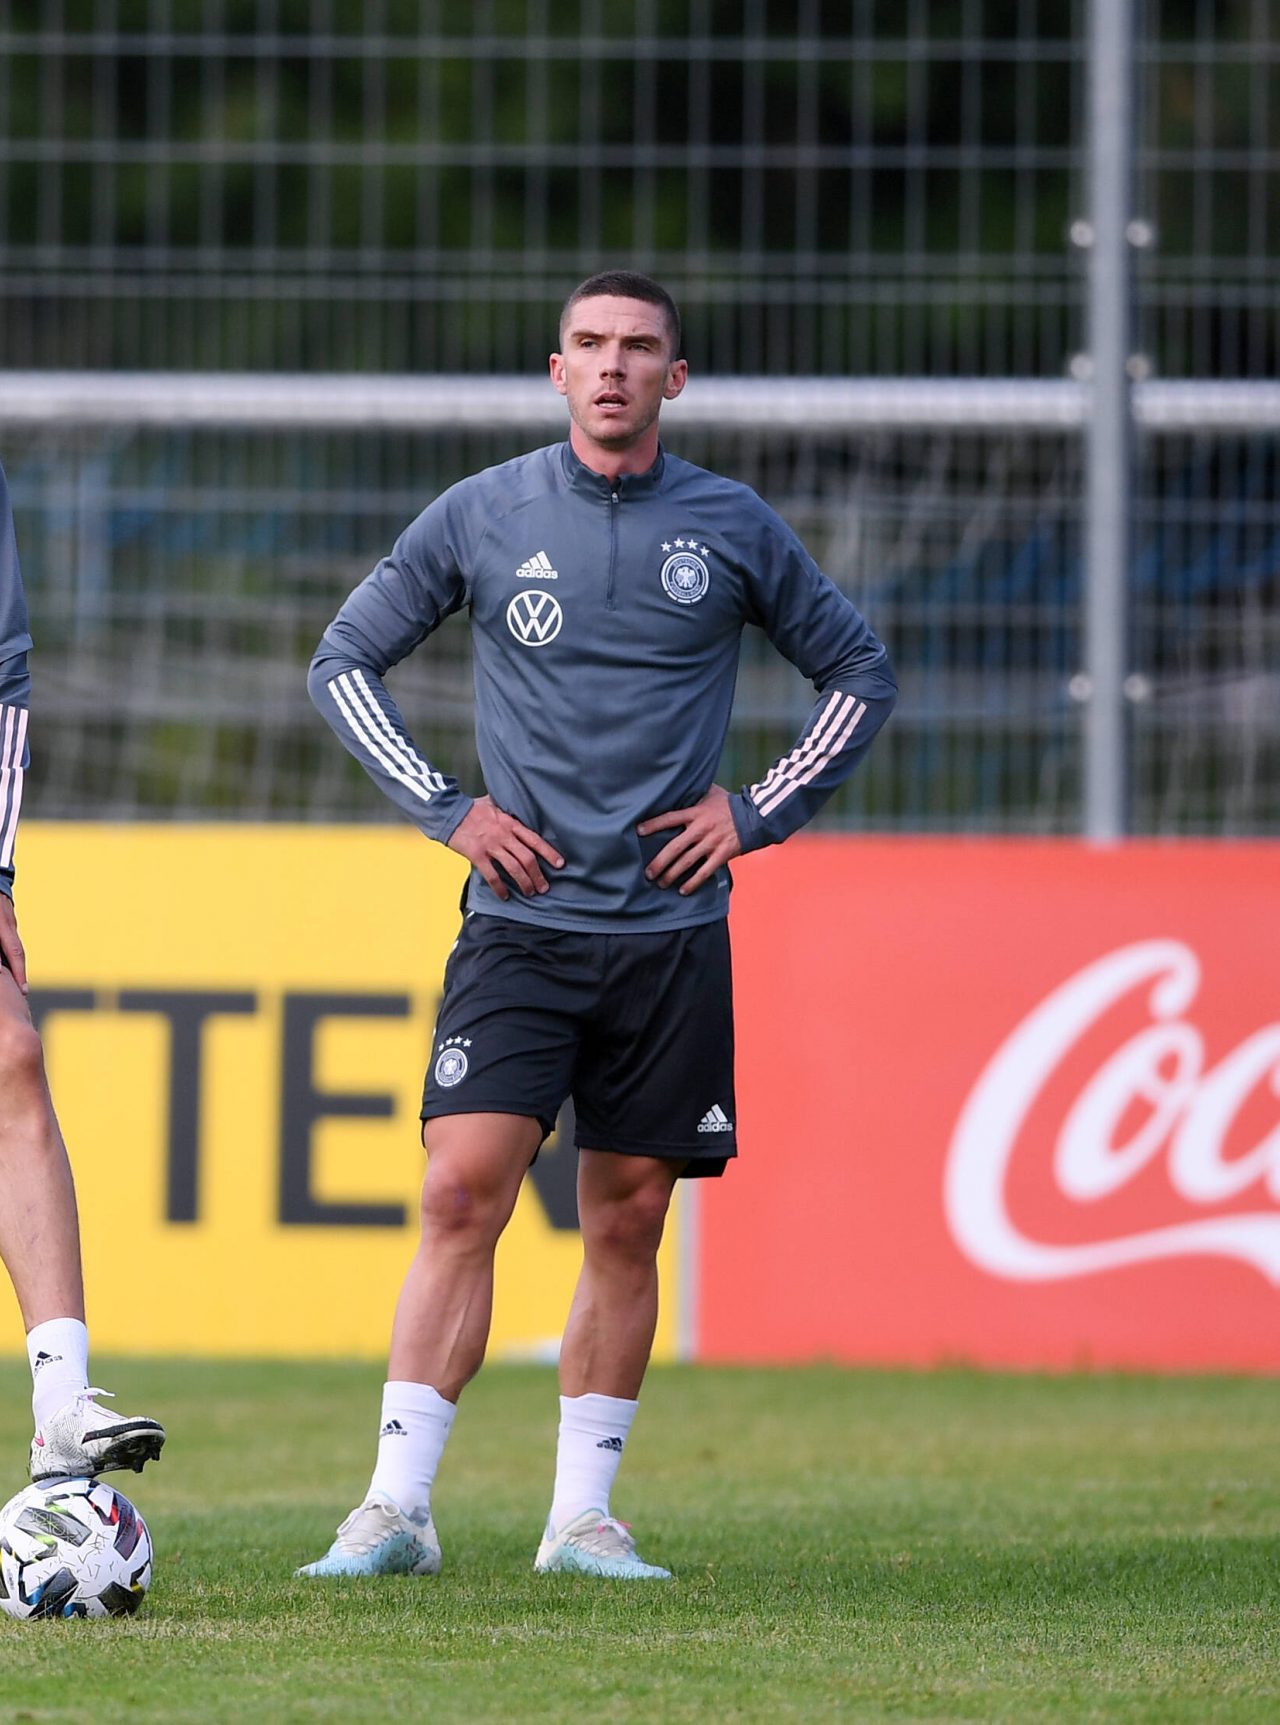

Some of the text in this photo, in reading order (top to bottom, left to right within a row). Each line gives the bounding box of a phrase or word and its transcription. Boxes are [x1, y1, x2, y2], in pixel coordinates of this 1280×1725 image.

[515, 567, 559, 580] adidas
[506, 590, 563, 647] VW
[696, 1121, 734, 1133] adidas
[944, 938, 1280, 1288] Coc
